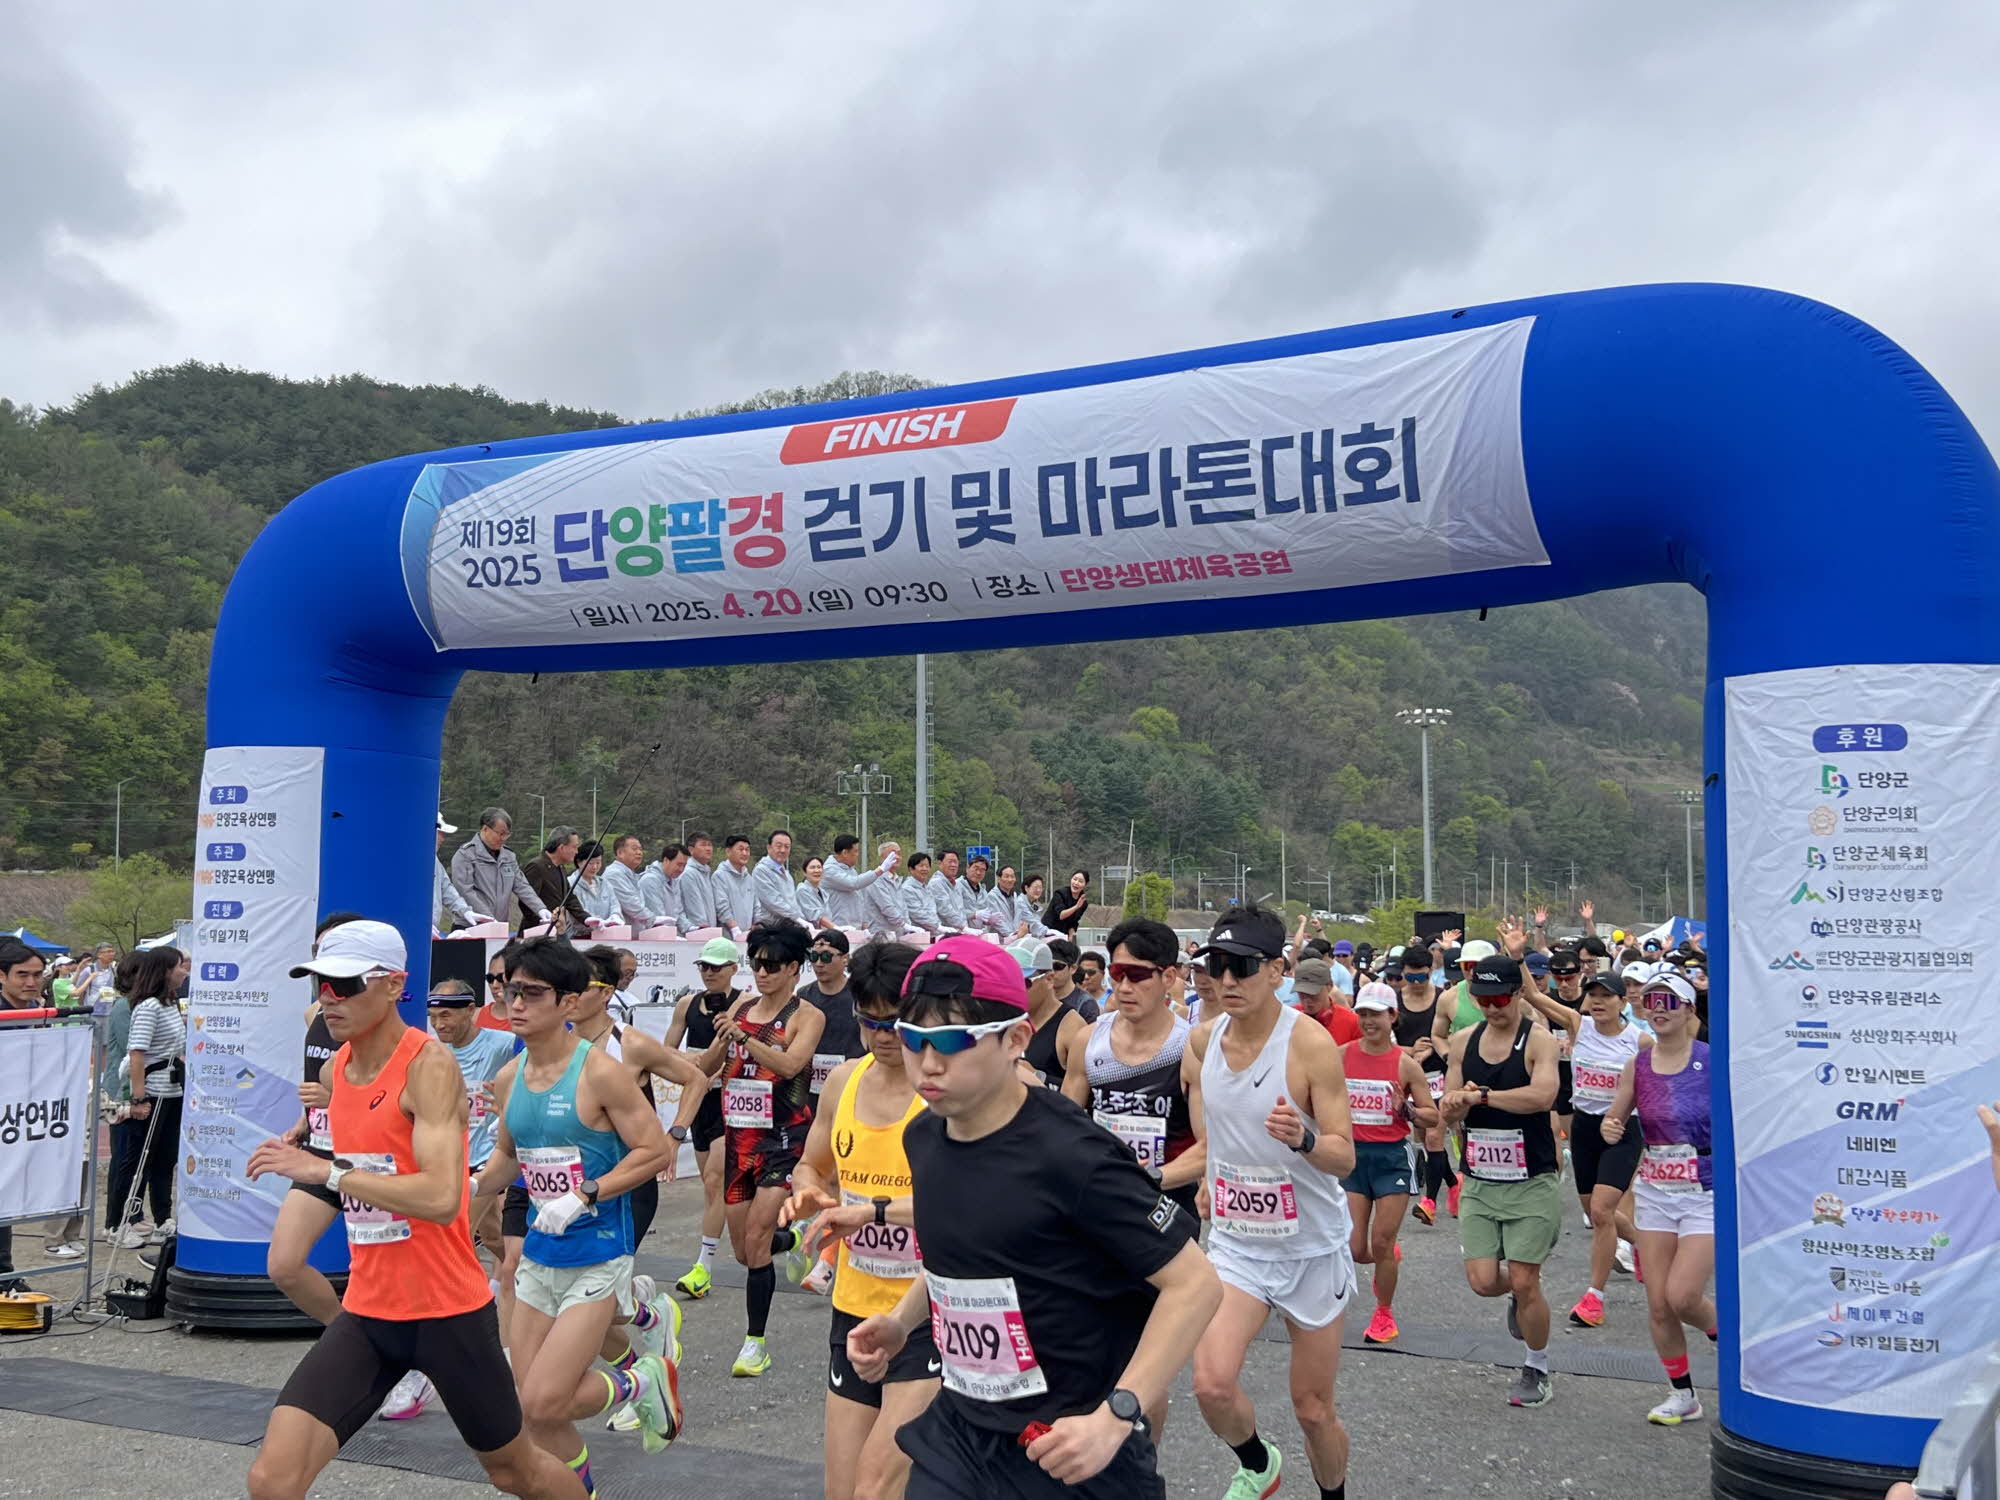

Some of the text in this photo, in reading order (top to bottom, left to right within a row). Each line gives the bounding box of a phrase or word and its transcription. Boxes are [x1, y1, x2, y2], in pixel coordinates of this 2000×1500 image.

[823, 410, 966, 454] FINISH
[553, 416, 1422, 583] 단양팔경 걷기 및 마라톤대회
[460, 515, 537, 549] 제19회
[466, 554, 542, 588] 2025
[864, 580, 949, 607] 09:30
[1059, 549, 1294, 593] 단양생태체육공원
[1857, 771, 1909, 790] 단양군
[217, 788, 237, 803] 주최
[216, 811, 277, 828] 단양군육상연맹
[1843, 806, 1918, 822] 단양군의회
[214, 845, 235, 860] 주관
[1832, 845, 1928, 862] 단양군체육회
[215, 869, 276, 885] 단양군육상연맹
[1848, 887, 1943, 903] 단양군산림조합
[211, 903, 232, 918] 진행
[1835, 918, 1922, 935] 단양관광공사
[209, 929, 249, 943] 대일기획
[636, 952, 676, 966] 단양군의회
[1828, 950, 1974, 967] 단양군관광지질협의회
[1828, 990, 1943, 1006] 단양국유림관리소
[206, 1015, 241, 1028] 단양경찰서
[1785, 1030, 1841, 1040] SUNGSHIN
[1850, 1029, 1957, 1044] 성신양회주식회사
[205, 1043, 245, 1056] 단양소방서
[1583, 1071, 1615, 1088] 2638
[1845, 1067, 1927, 1085] 한일시멘트
[730, 1096, 762, 1112] 2058
[1350, 1094, 1383, 1110] 2628
[1836, 1101, 1899, 1121] GRM
[0, 1097, 70, 1145] 상연맹
[1846, 1136, 1897, 1153] 네비엔
[1478, 1146, 1512, 1163] 2112
[840, 1170, 869, 1184] TEAM
[1649, 1162, 1688, 1180] 2622
[1837, 1168, 1908, 1188] 대강식품
[529, 1170, 570, 1193] 2063
[1216, 1184, 1226, 1211] Half
[1227, 1187, 1278, 1214] 2059
[1282, 1190, 1295, 1213] Half
[853, 1224, 909, 1251] 2049
[1801, 1238, 1936, 1262] 향산산약초영농조합
[943, 1317, 1000, 1360] 2109
[1008, 1323, 1032, 1361] Half
